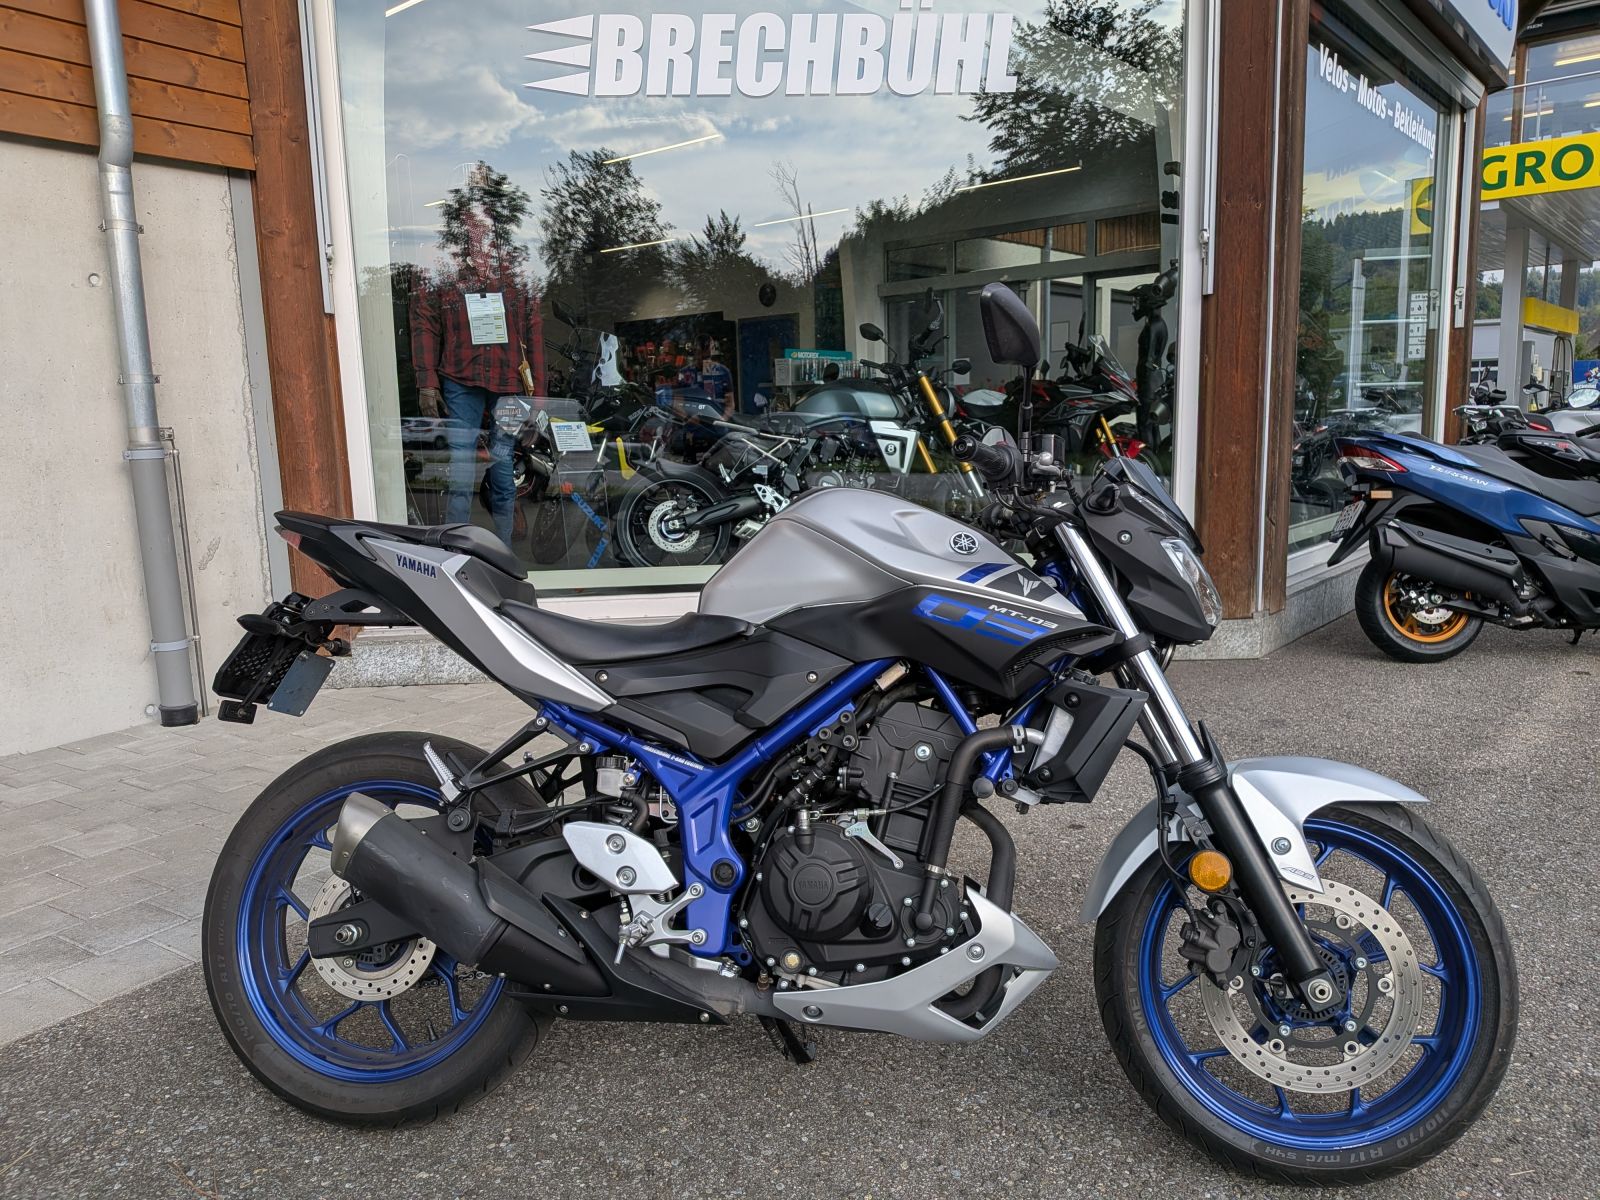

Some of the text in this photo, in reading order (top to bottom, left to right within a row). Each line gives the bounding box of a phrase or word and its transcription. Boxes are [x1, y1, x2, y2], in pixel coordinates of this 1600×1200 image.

[594, 0, 1018, 96] BRECHBÜHL
[1319, 43, 1349, 93] Velos
[1357, 73, 1387, 119] Motos
[1394, 101, 1436, 159] Bekleidung
[396, 554, 437, 578] YAMAHA
[989, 604, 1058, 629] MT-03
[1281, 867, 1315, 880] ABS
[1396, 1107, 1450, 1151] 110/70
